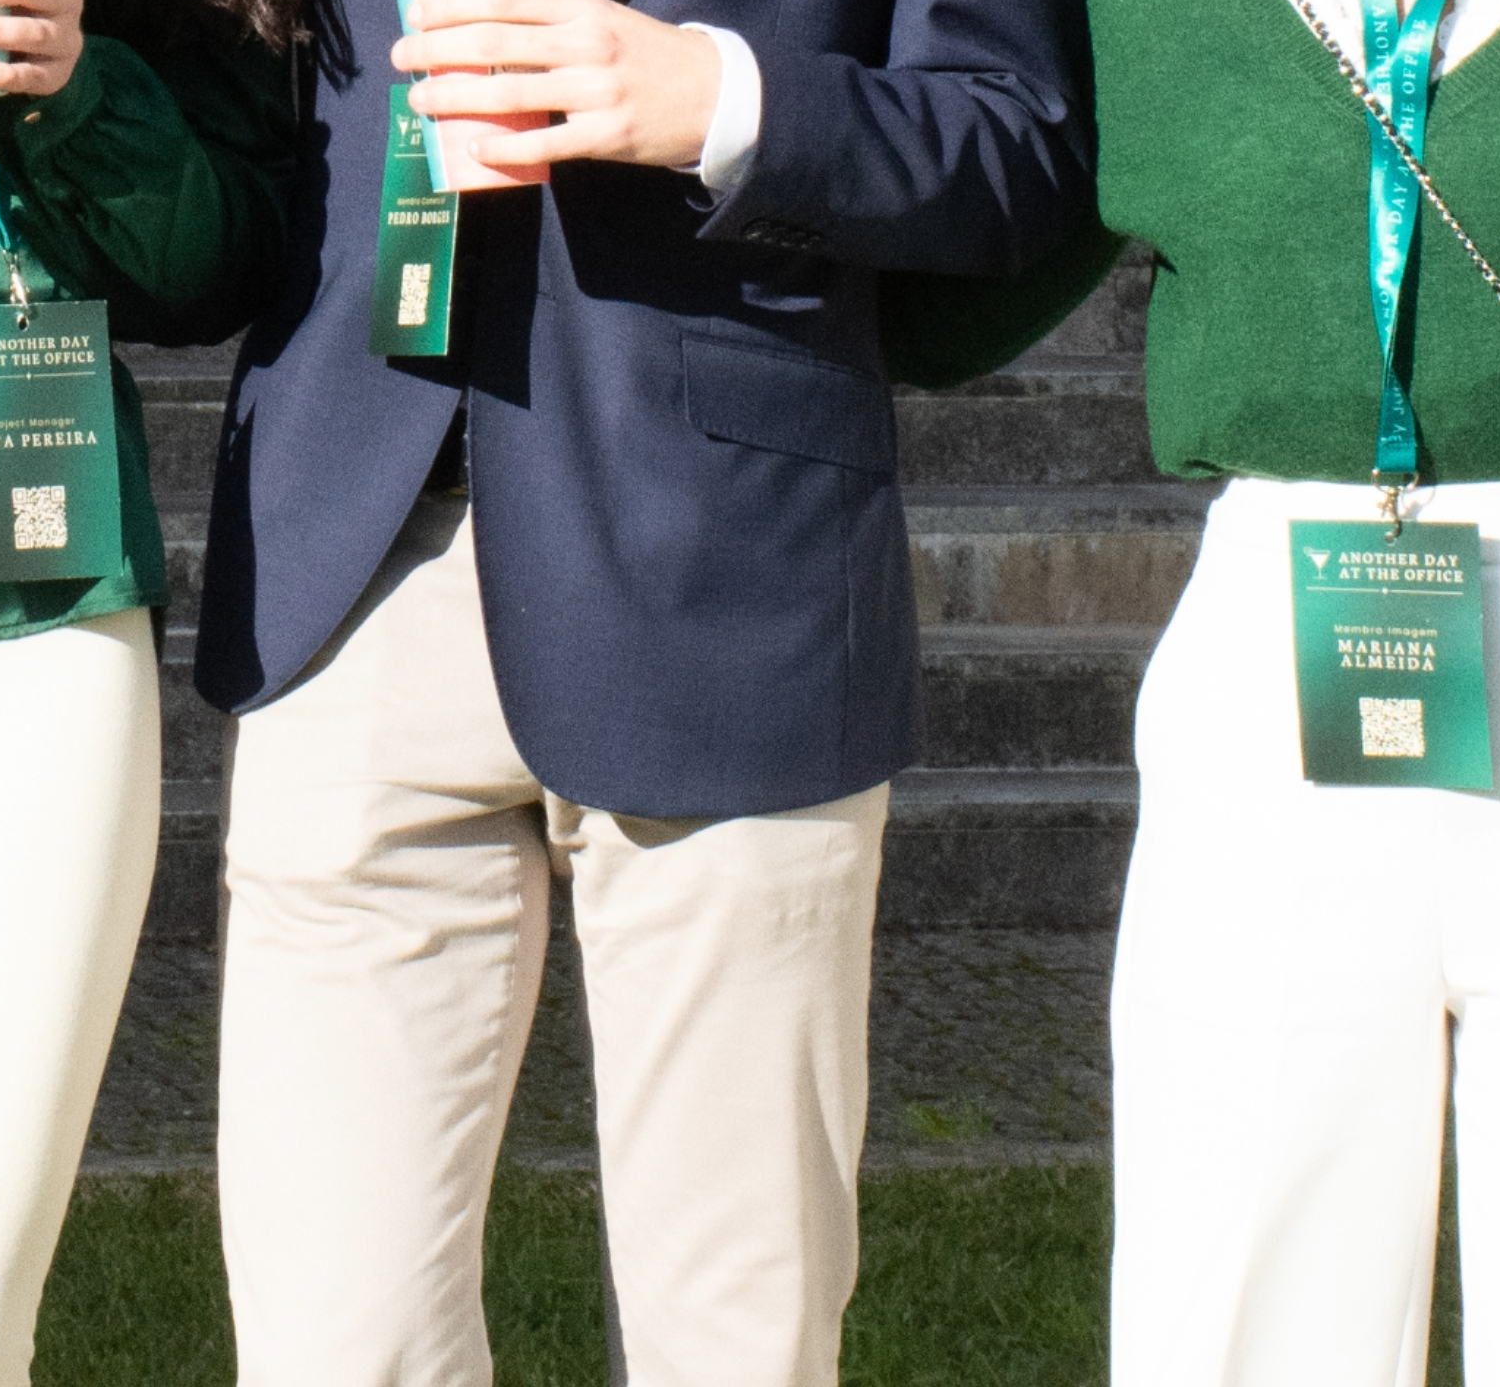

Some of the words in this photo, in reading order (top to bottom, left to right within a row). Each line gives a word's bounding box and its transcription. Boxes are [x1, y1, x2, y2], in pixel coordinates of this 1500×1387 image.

[1372, 6, 1391, 93] ANOTHE
[1388, 182, 1410, 224] DAY
[1402, 18, 1428, 96] OFFICE
[387, 211, 419, 225] PEDRO
[61, 335, 90, 349] DAY
[12, 353, 40, 367] THE
[44, 350, 96, 365] OFFICE
[21, 430, 98, 448] PEREIRA
[1338, 552, 1419, 567] ANOTHER
[1424, 554, 1459, 568] DAY
[1338, 567, 1360, 581] AT
[1365, 567, 1399, 582] THE
[1404, 569, 1465, 584] OFFICE
[1338, 639, 1436, 658] MARIANA
[1340, 654, 1435, 672] ALMEIDA
